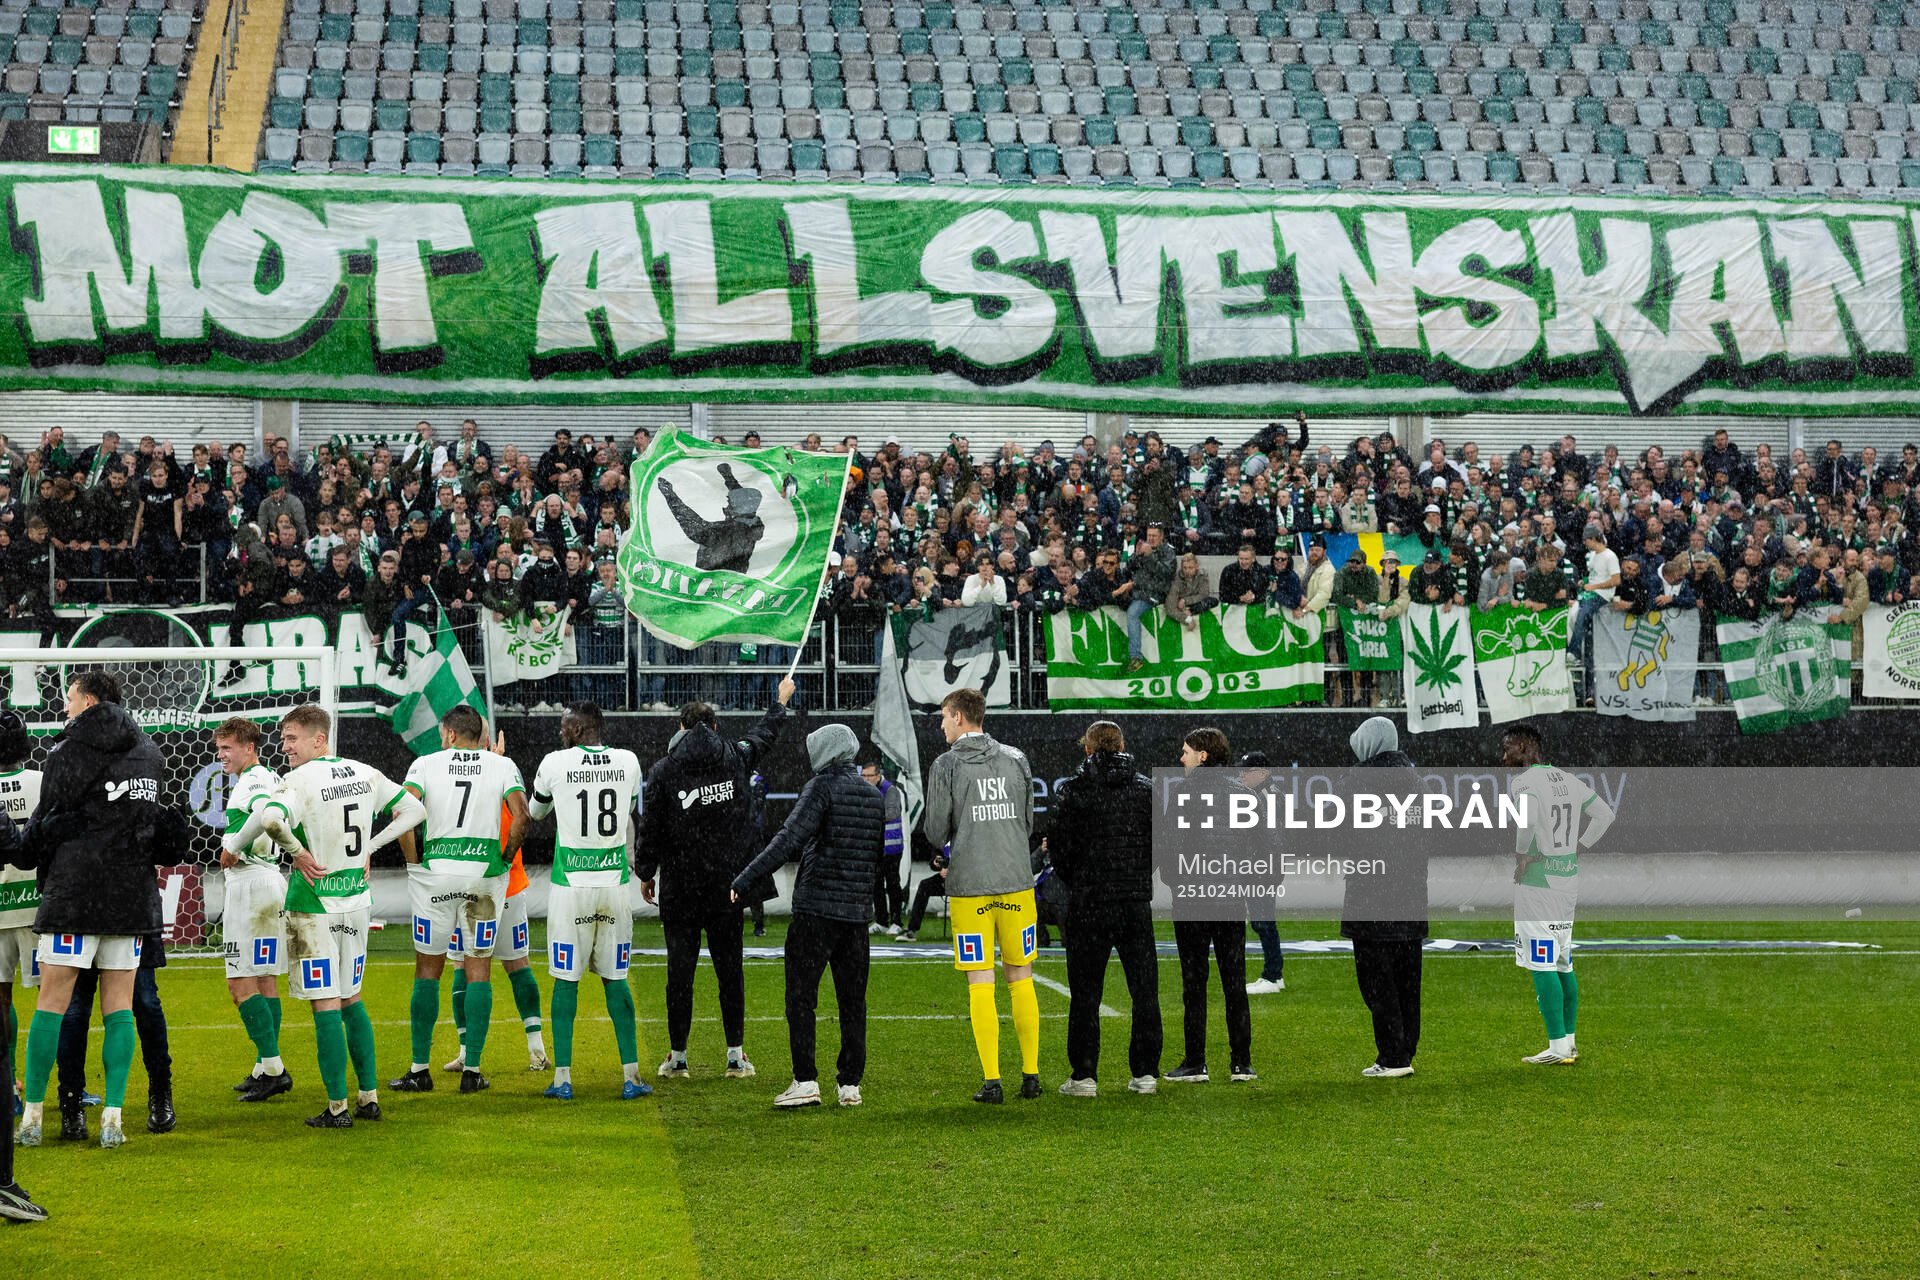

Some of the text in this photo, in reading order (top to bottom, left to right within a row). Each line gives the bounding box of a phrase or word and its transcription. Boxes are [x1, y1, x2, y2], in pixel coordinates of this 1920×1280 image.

[12, 180, 1909, 410] MOT ALLSVENSKAN
[1128, 672, 1261, 696] 20 03
[451, 752, 481, 762] ABB
[581, 754, 611, 765] ABB
[448, 764, 481, 776] RIBEIRO
[566, 770, 625, 783] NSABIYUMVA
[129, 778, 157, 791] INTER
[320, 781, 373, 802] GUNNARSSON
[701, 780, 734, 796] INTER
[977, 777, 1008, 801] VSK
[129, 789, 157, 802] SPORT
[455, 780, 472, 828] 7
[701, 790, 735, 805] SPORT
[576, 788, 618, 837] 18
[973, 803, 1017, 822] FOTBOLL
[343, 803, 362, 857] 5
[1551, 803, 1572, 848] 27
